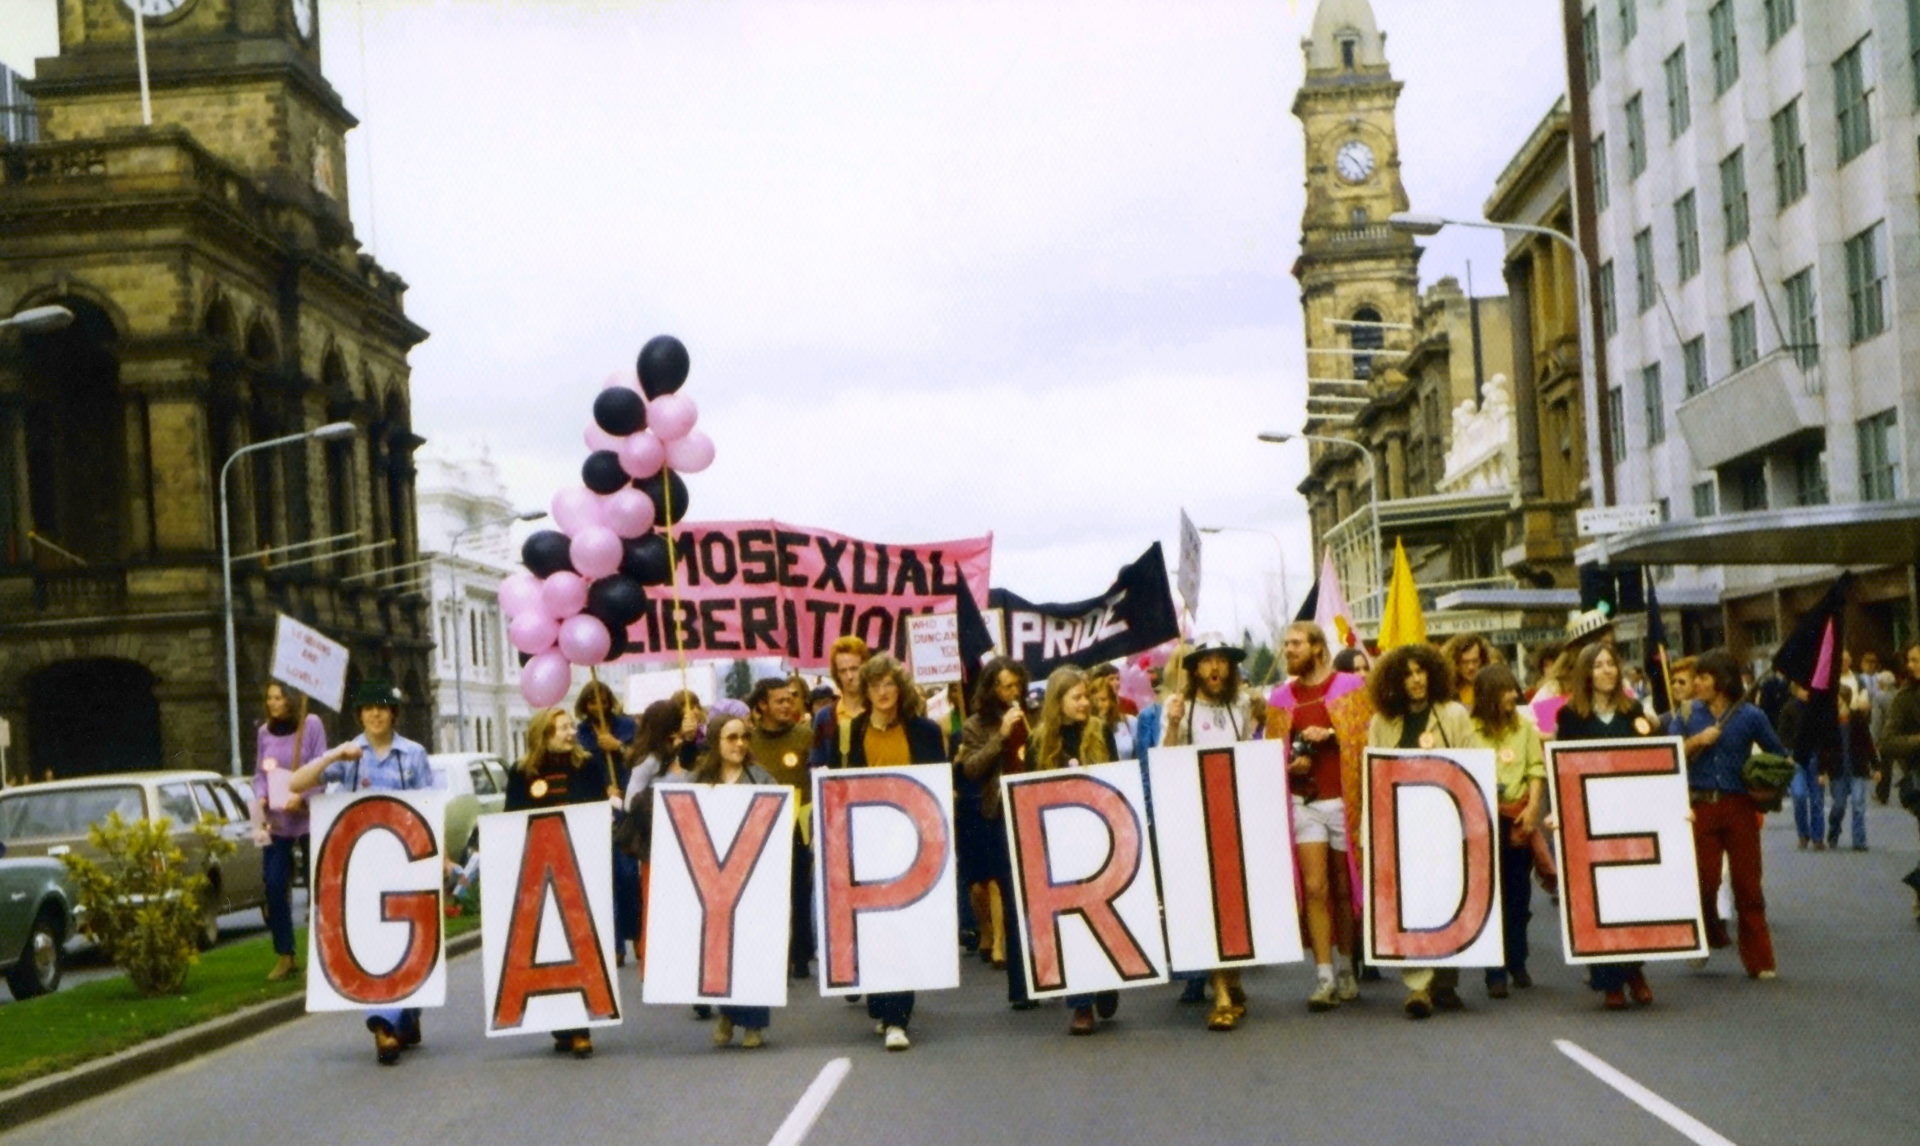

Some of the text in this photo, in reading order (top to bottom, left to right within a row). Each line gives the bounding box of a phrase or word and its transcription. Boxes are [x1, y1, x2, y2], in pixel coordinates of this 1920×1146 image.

[664, 528, 957, 595] MOSEXUAL
[912, 619, 936, 629] WHO
[1011, 587, 1129, 662] PRIDE
[314, 742, 1701, 1031] GAY PRIDE
